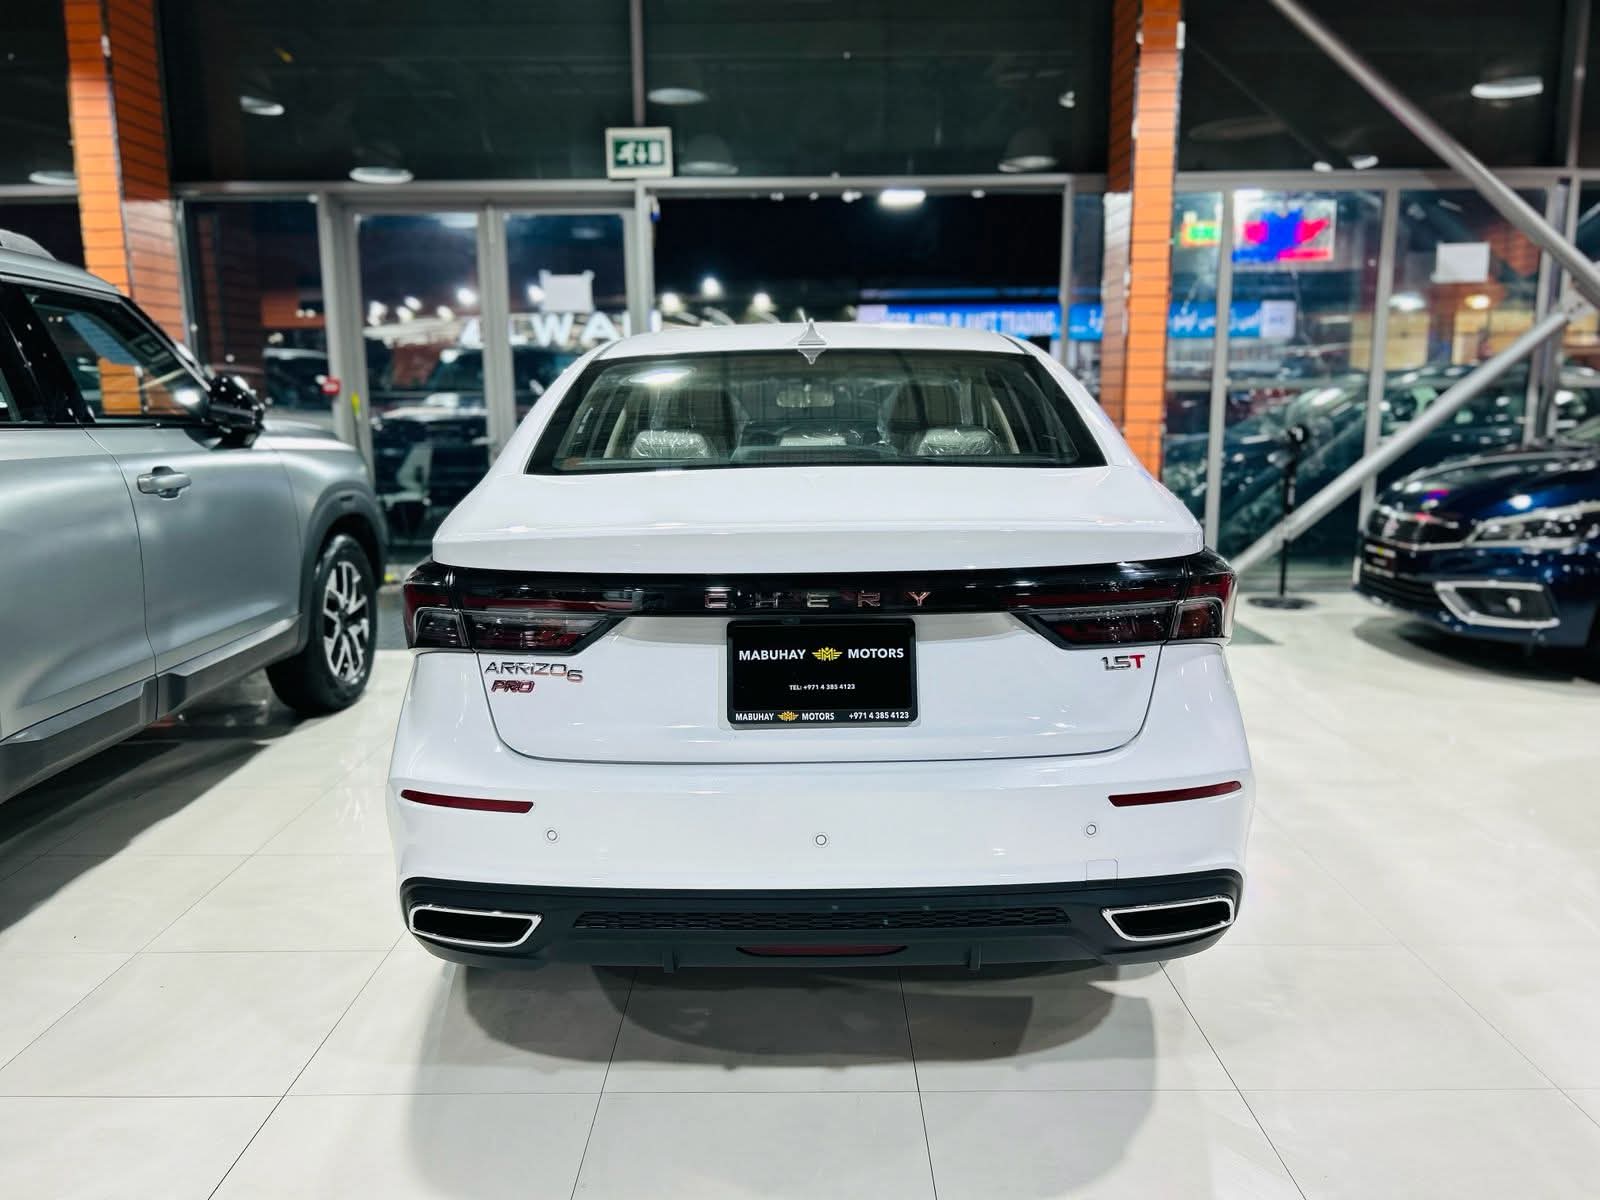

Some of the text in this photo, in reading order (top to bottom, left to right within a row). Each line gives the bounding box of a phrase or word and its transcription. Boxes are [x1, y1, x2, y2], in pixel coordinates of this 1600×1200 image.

[704, 591, 931, 608] CHERY
[738, 647, 905, 661] MABUHAY MOTORS
[491, 679, 535, 693] PRO
[735, 711, 910, 721] MABUHAY MOTORS +971 4 385 4123
